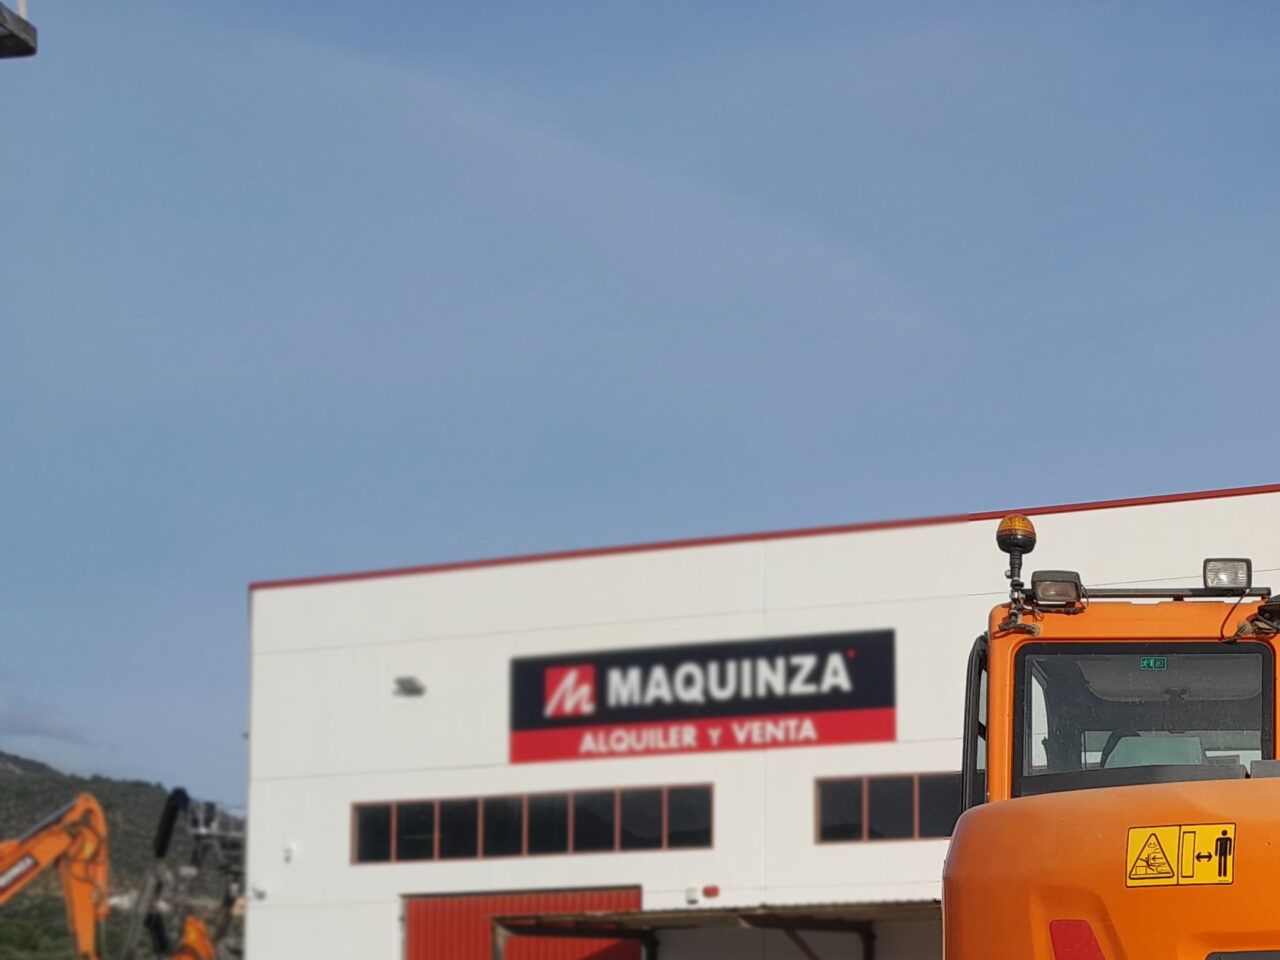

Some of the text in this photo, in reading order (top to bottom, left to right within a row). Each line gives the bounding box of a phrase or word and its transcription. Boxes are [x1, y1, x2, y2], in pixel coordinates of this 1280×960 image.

[607, 652, 851, 707] MAQUINZA
[579, 719, 817, 755] ALQUILER Y VENTA
